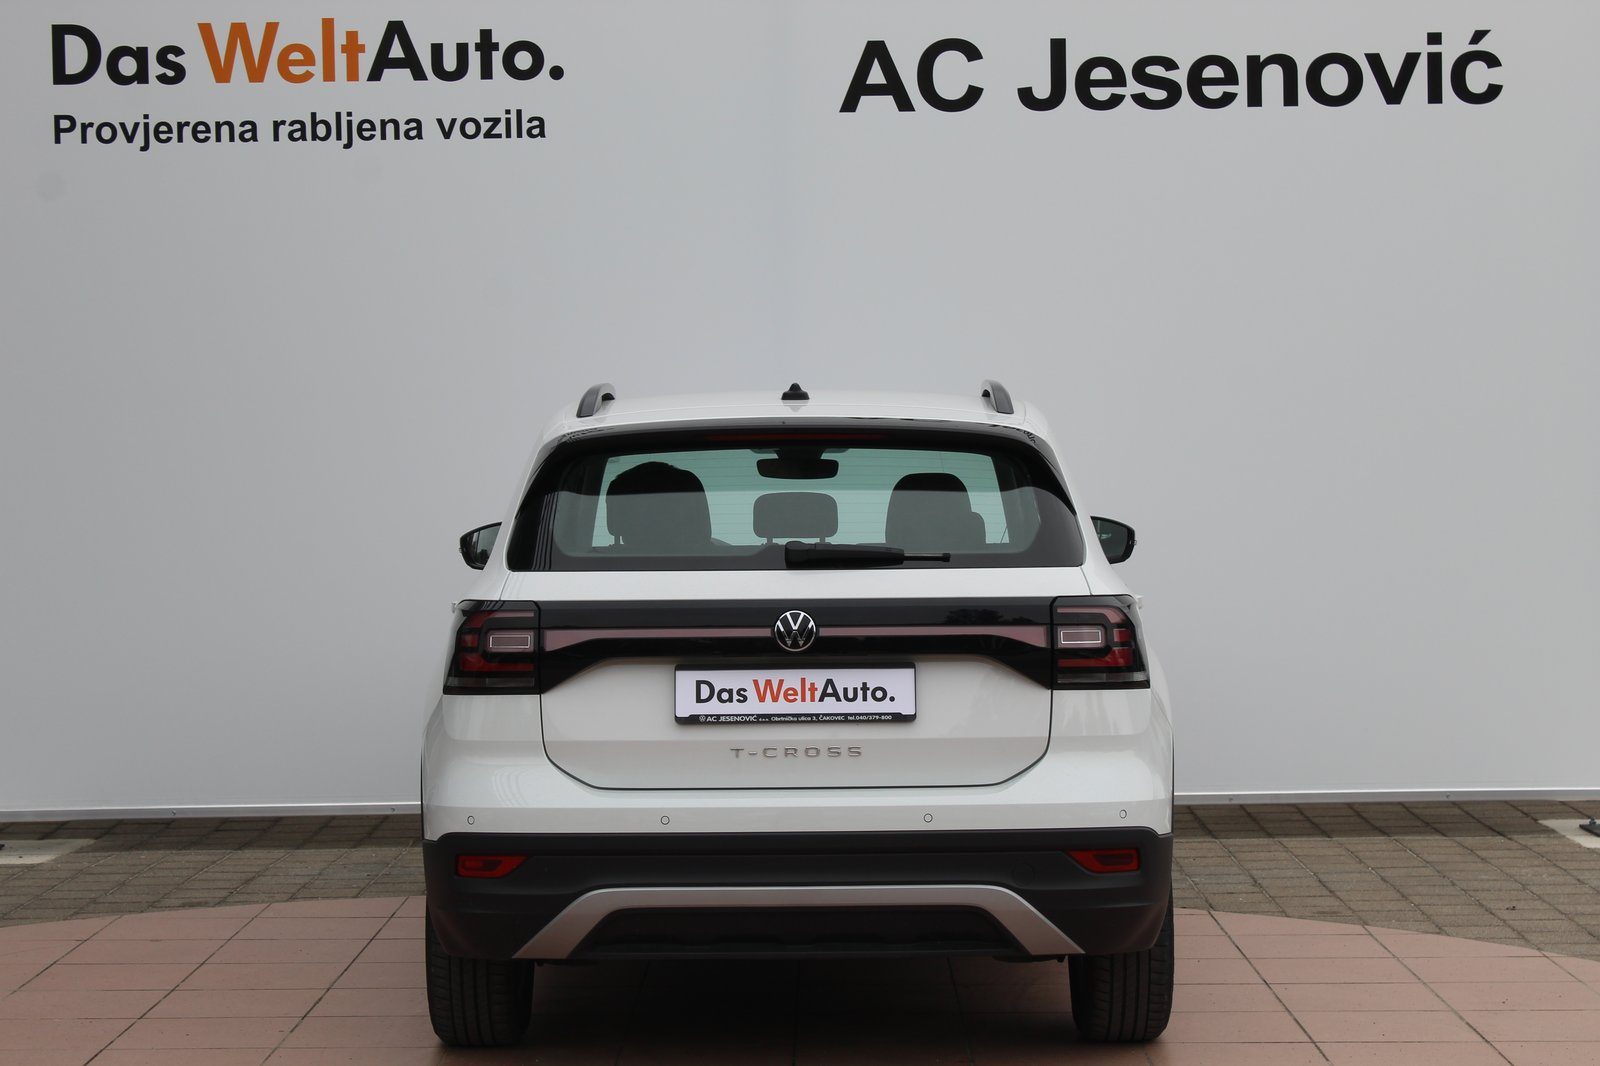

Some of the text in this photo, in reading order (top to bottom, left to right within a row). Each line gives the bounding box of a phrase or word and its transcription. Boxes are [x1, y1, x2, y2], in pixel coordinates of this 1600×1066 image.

[51, 18, 565, 87] Das WeltAuto.
[839, 29, 1504, 113] AC Jesenović
[53, 109, 546, 152] Provjerena rabljena vozila
[695, 677, 896, 704] Das WeltAuto.
[730, 745, 863, 759] T-CROSS
